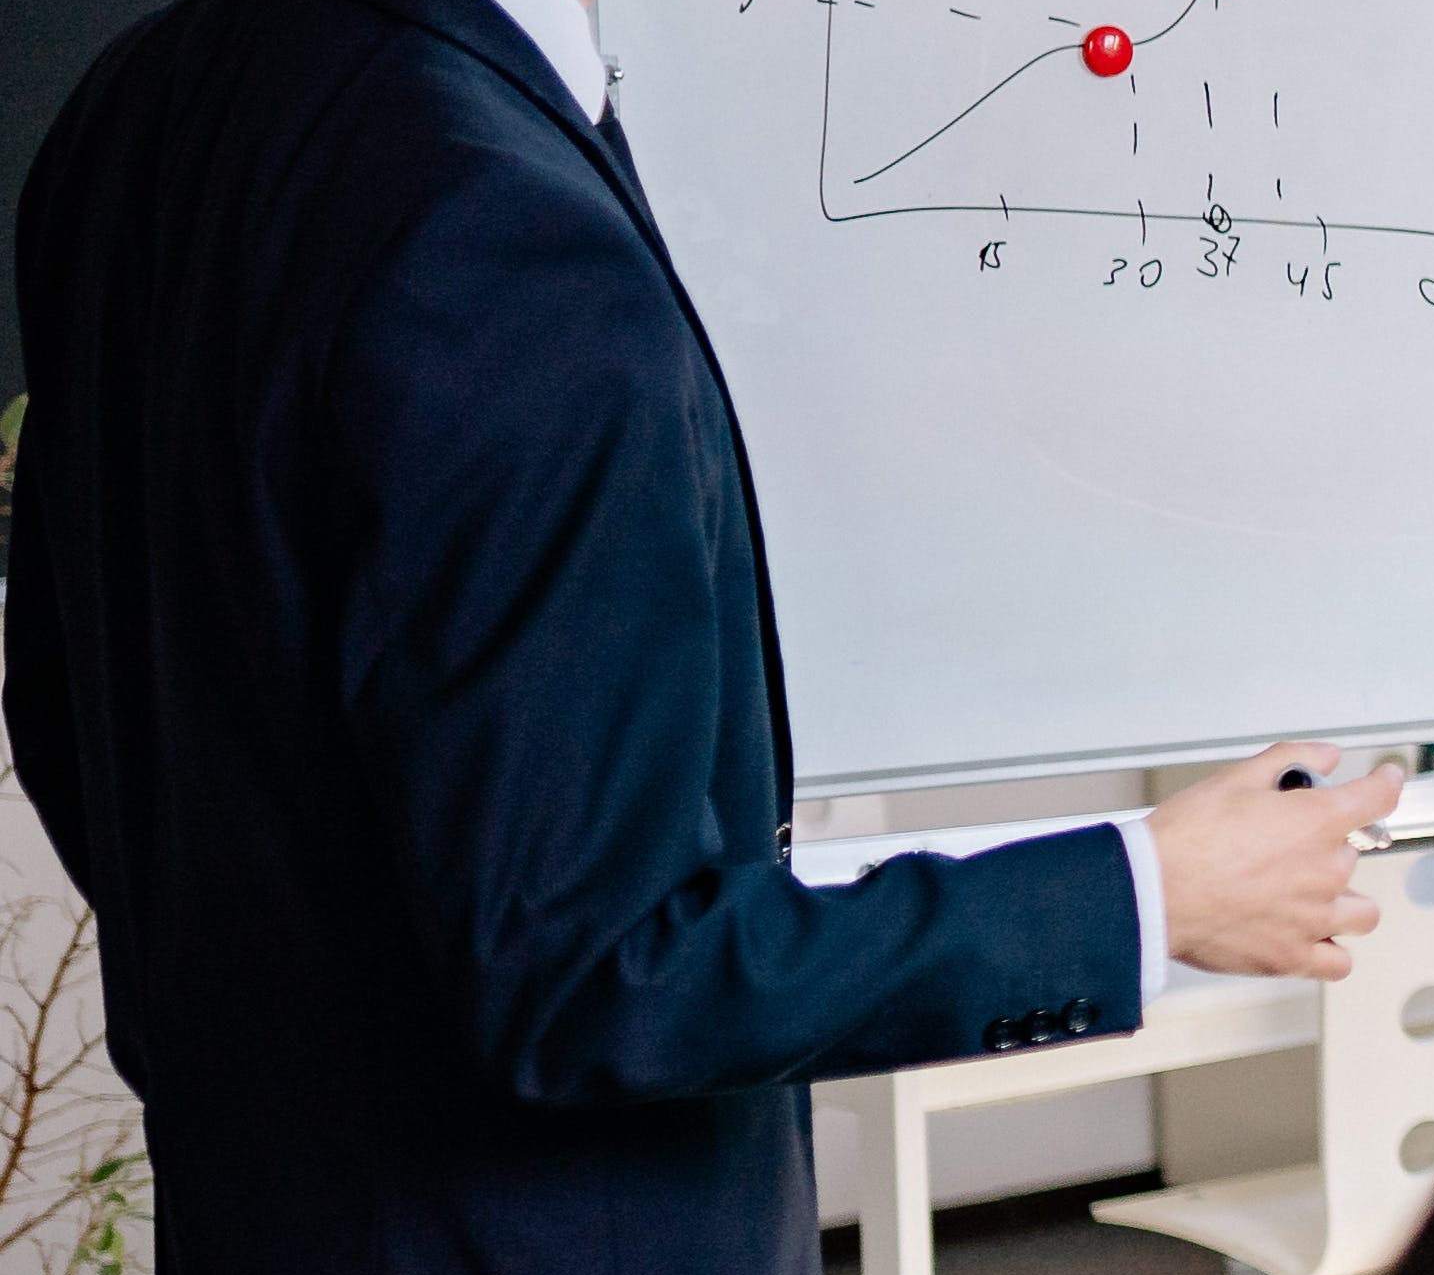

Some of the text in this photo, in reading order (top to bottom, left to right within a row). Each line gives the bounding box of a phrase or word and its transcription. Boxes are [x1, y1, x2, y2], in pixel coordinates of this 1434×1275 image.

[1102, 257, 1163, 289] 30
[1195, 236, 1241, 278] 37
[1286, 261, 1342, 301] 45
